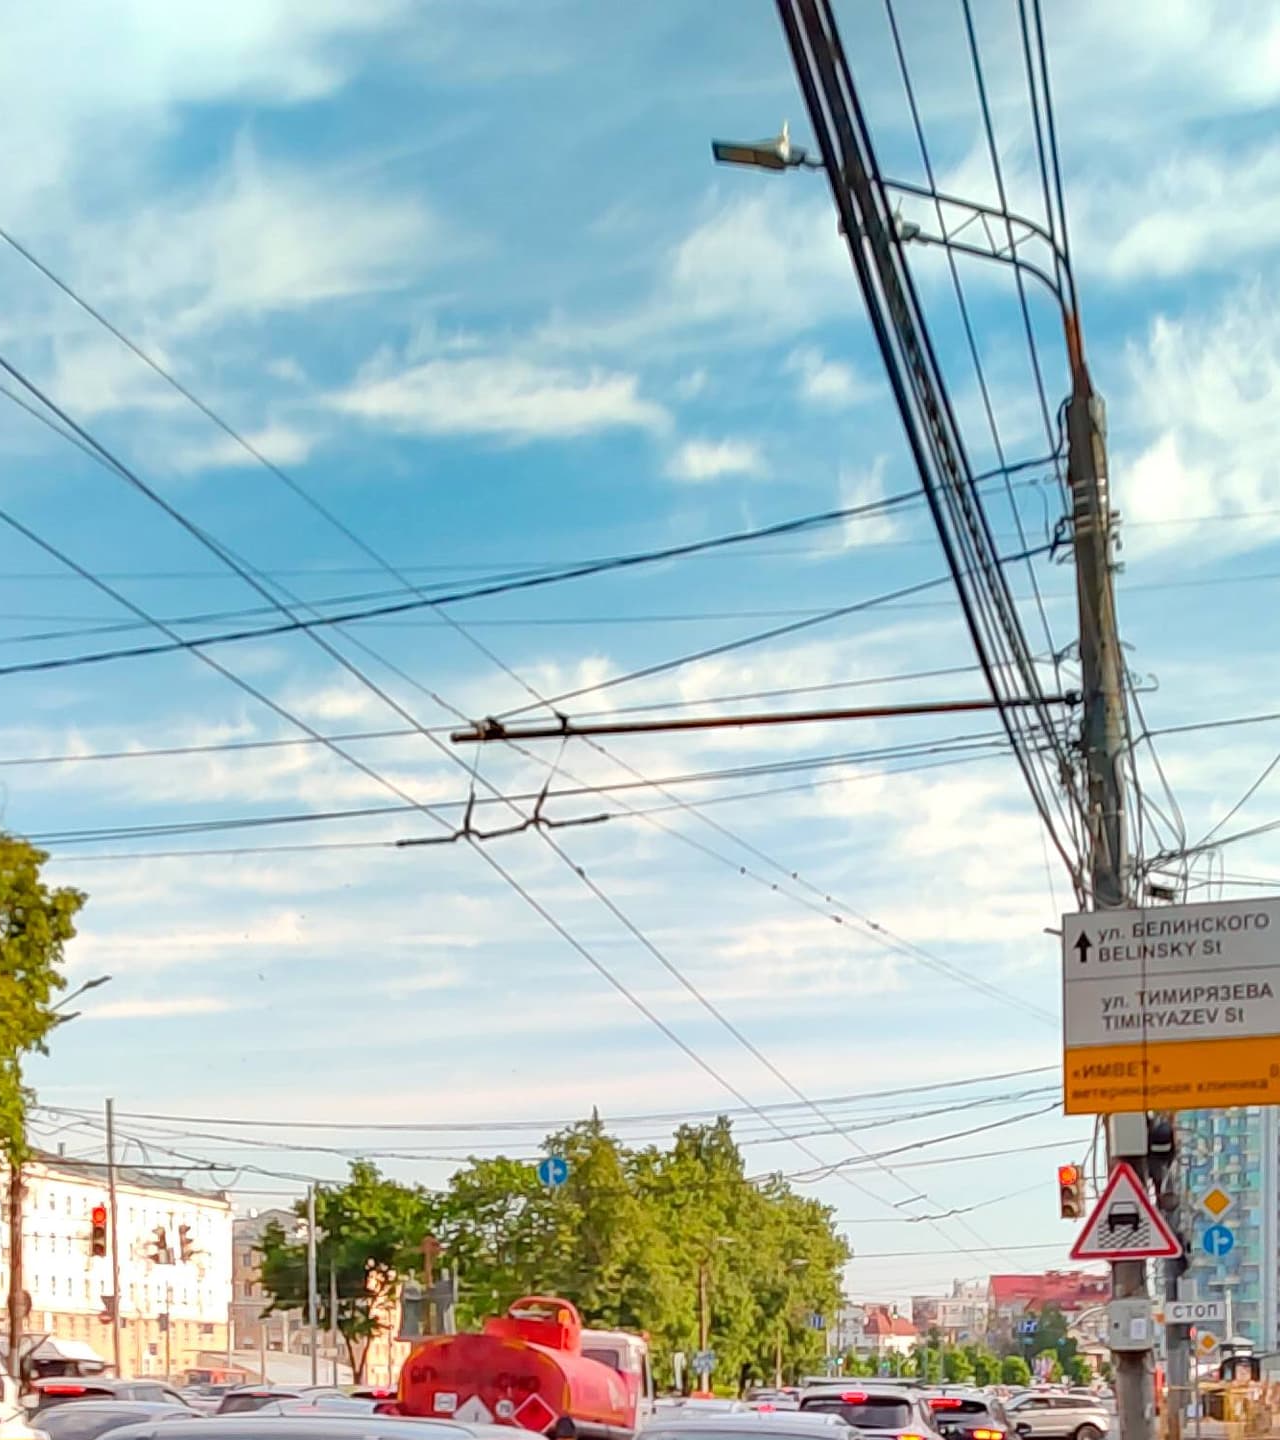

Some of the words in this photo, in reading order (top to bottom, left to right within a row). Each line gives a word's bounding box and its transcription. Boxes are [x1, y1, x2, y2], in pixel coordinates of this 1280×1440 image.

[1098, 928, 1126, 945] ул.
[1132, 913, 1270, 938] БЕЛИНСКОГО
[1098, 941, 1197, 962] BELINSKY
[1202, 939, 1223, 956] St
[1102, 996, 1129, 1012] ул.
[1136, 983, 1274, 1006] ТИМИРЯЗЕВА
[1102, 1008, 1219, 1031] TIMIRYAZEV
[1225, 1007, 1245, 1024] St
[1172, 1304, 1219, 1319] СТОП
